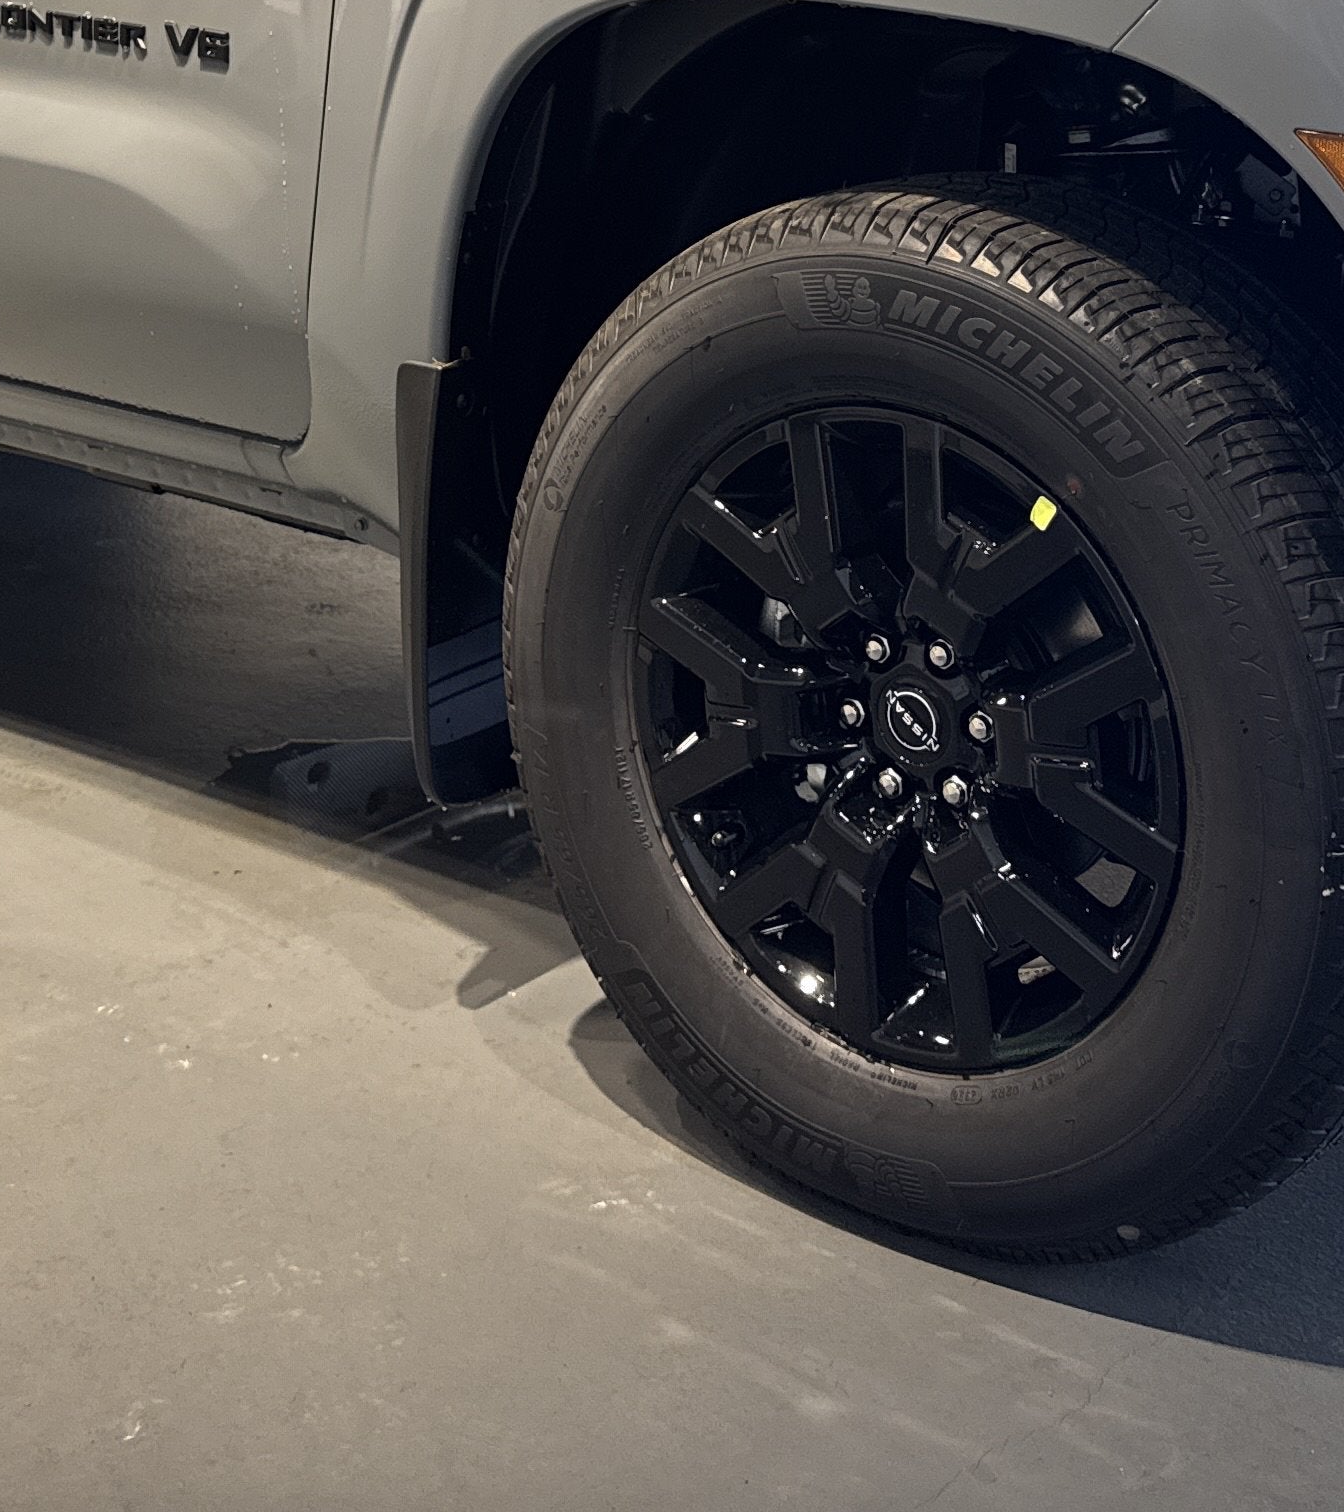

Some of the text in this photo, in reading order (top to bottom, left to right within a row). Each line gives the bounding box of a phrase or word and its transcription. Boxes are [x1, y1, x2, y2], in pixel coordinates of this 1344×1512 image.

[164, 19, 231, 66] V6
[887, 288, 1147, 466] MICHELIN
[1166, 501, 1268, 674] PRIMACY
[886, 690, 940, 752] NISSAN
[628, 980, 845, 1175] MICHELIN
